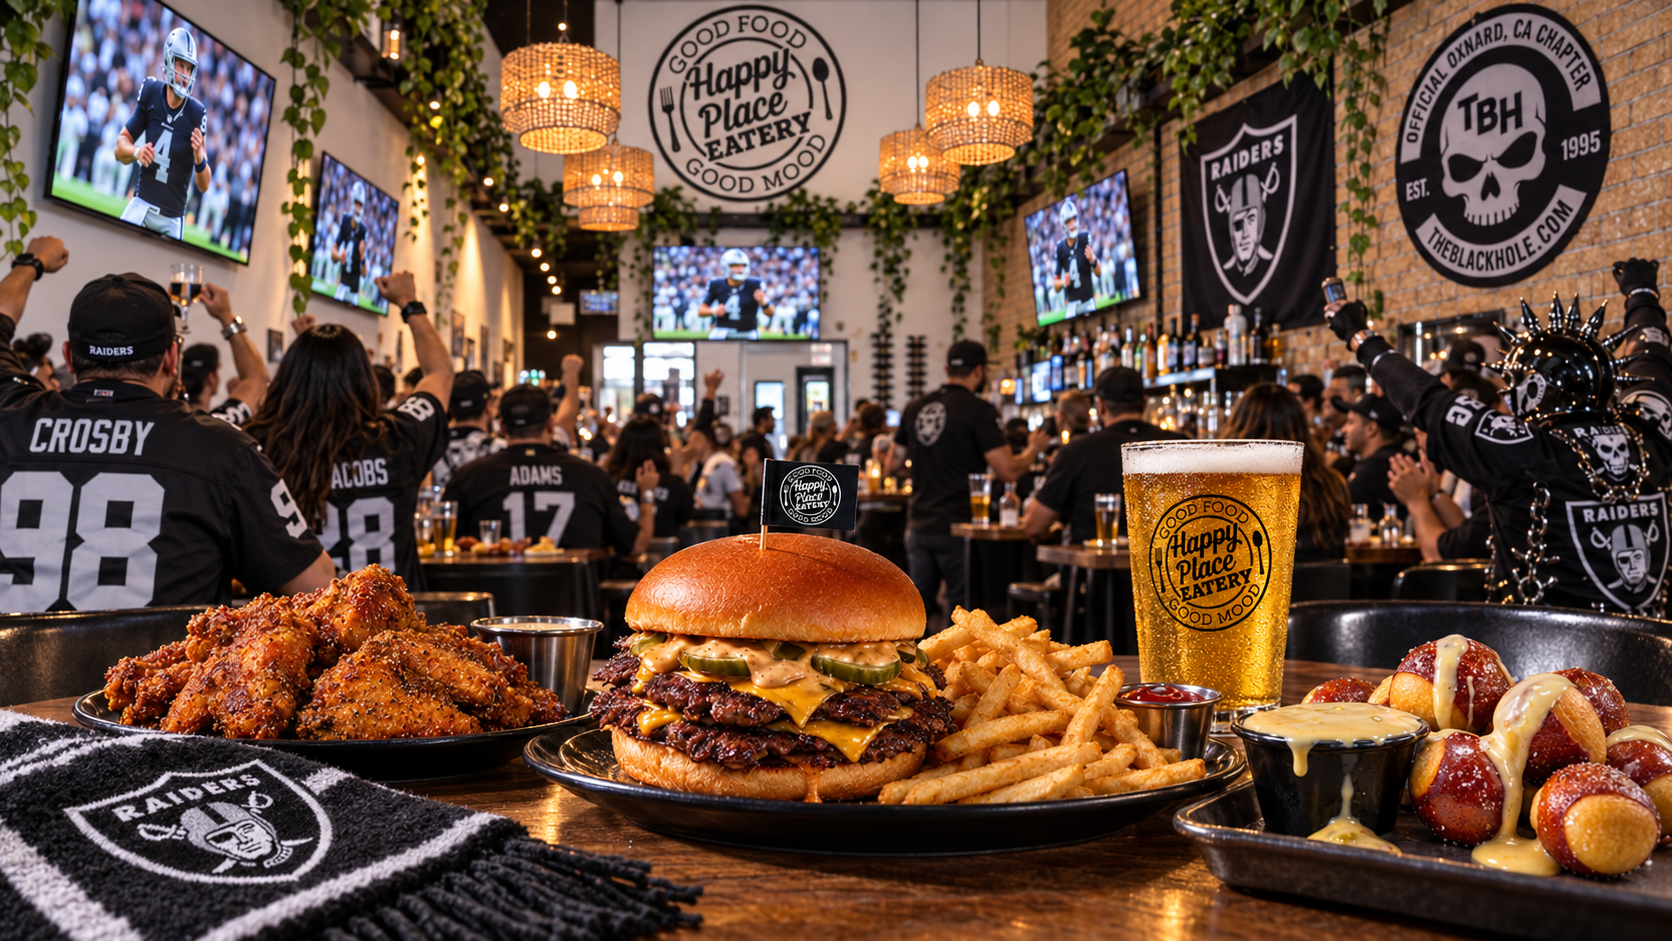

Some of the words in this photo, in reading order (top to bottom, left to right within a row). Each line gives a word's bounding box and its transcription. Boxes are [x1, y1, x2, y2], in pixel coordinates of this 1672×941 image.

[669, 20, 730, 74] GOOD
[738, 15, 807, 49] FOOD
[685, 48, 797, 101] Happy
[1406, 69, 1448, 143] OFFICIAL
[1446, 22, 1508, 68] OXNARD,
[1513, 19, 1532, 40] CA
[1536, 24, 1592, 92] CHAPTER
[698, 92, 788, 138] Place
[1457, 90, 1523, 136] TBH
[152, 129, 173, 184] 4
[704, 111, 811, 162] EATERY
[1211, 134, 1284, 181] RAIDERS
[1560, 130, 1601, 160] 1995
[686, 158, 754, 193] GOOD
[761, 134, 826, 191] MOOD
[1405, 178, 1430, 201] EST.
[1427, 198, 1574, 271] THEBLACKHOLE.COM
[1069, 258, 1081, 289] 4
[724, 294, 741, 320] 4
[89, 345, 134, 357] RAIDERS
[29, 418, 155, 456] CROSBY
[330, 457, 389, 490] ACOBS
[509, 466, 562, 486] ADAMS
[503, 491, 576, 550] 17
[1160, 503, 1198, 539] GOOD
[1203, 500, 1249, 524] FOOD
[1582, 502, 1659, 523] RAIDERS
[0, 470, 166, 612] 98
[1170, 522, 1242, 558] Happy
[1176, 554, 1237, 585] Place
[1179, 568, 1252, 602] EATERY
[1169, 598, 1213, 625] GOOD
[1217, 583, 1260, 624] MOOD
[111, 774, 260, 822] RAIDERS
